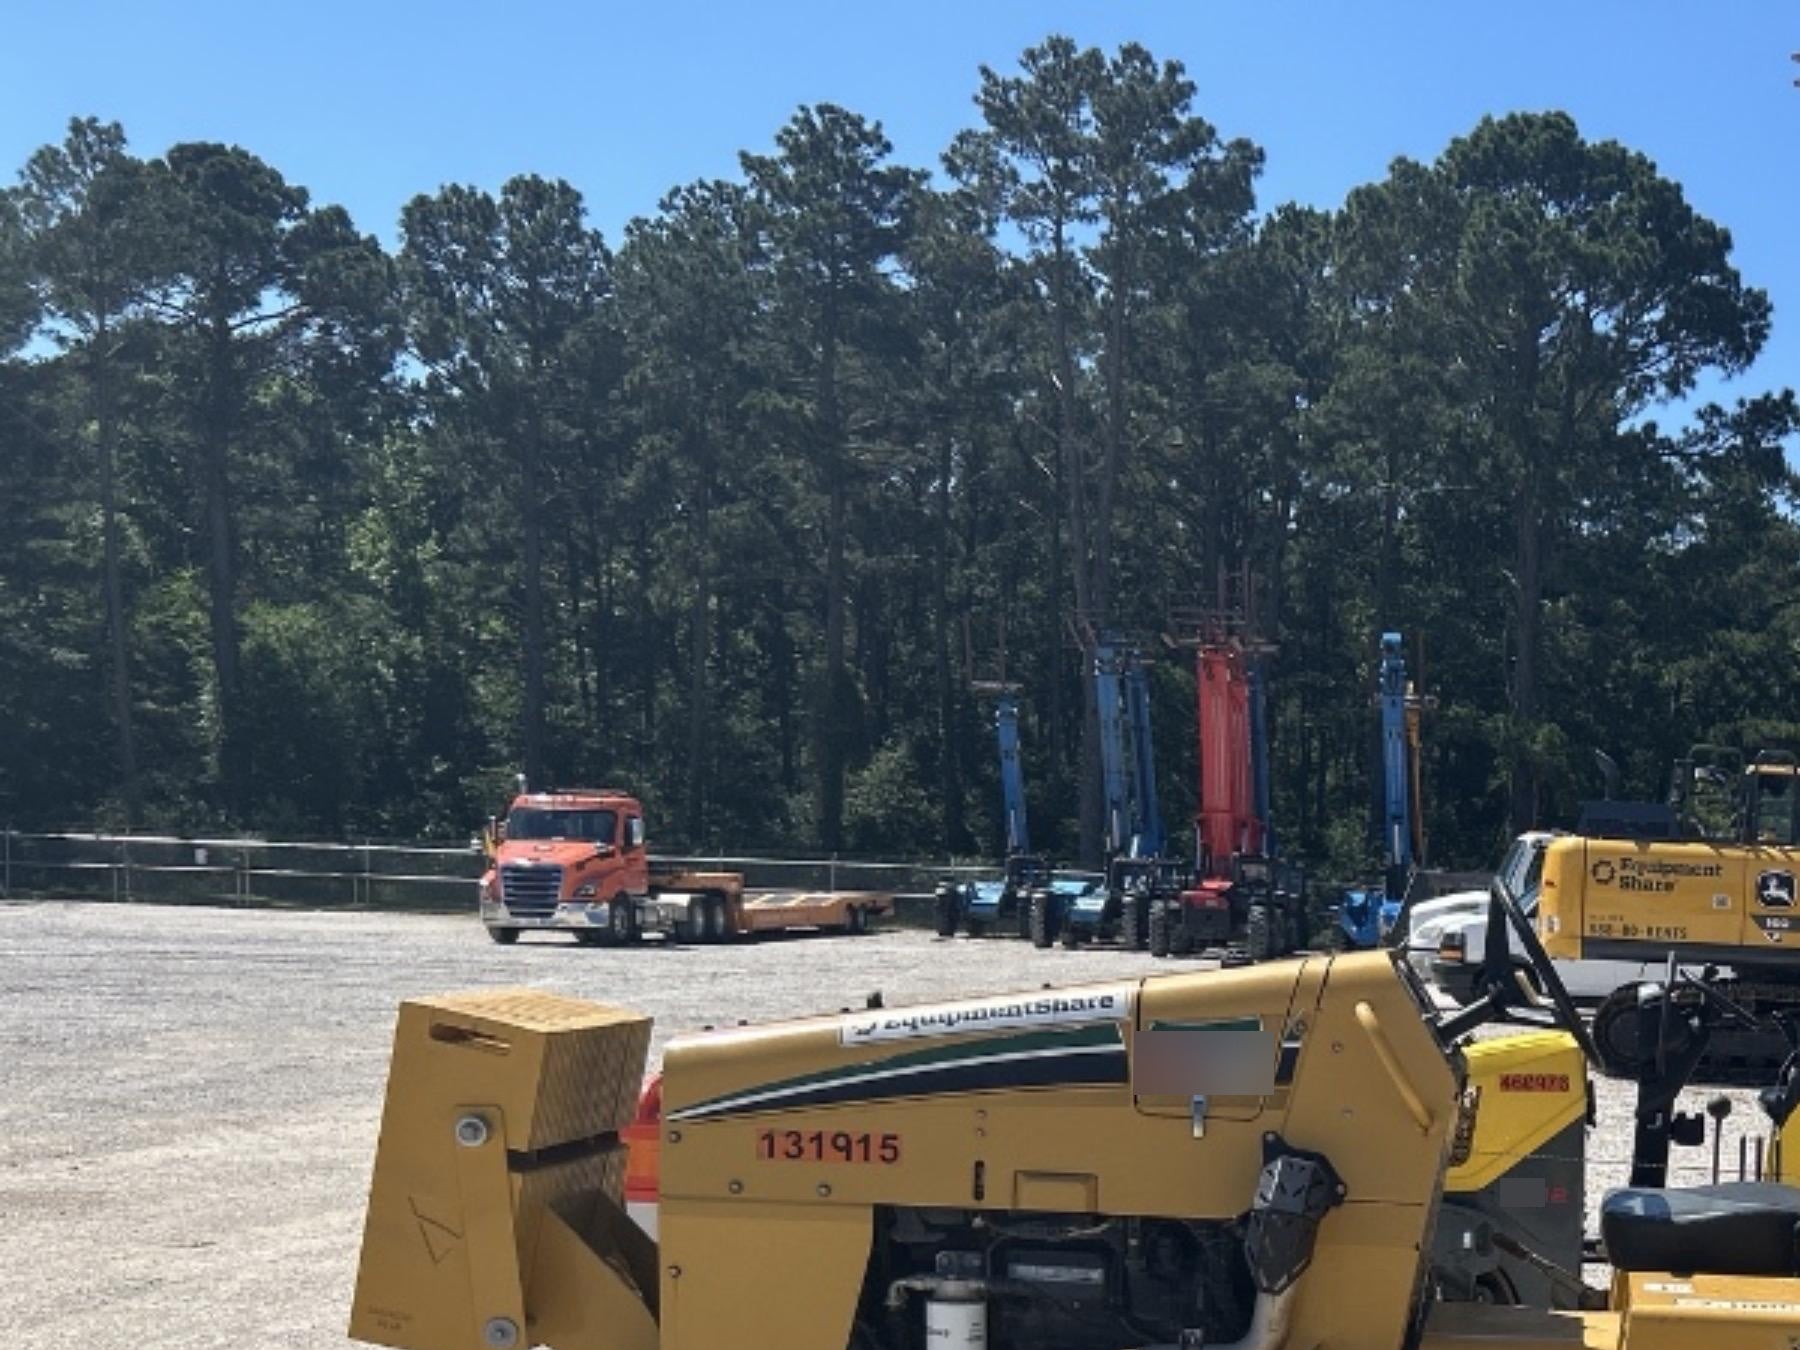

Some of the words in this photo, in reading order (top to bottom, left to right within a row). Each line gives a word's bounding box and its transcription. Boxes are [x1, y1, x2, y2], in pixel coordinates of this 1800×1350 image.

[1619, 857, 1723, 878] Equipment
[1619, 875, 1675, 892] Share
[758, 1130, 901, 1165] 131915
